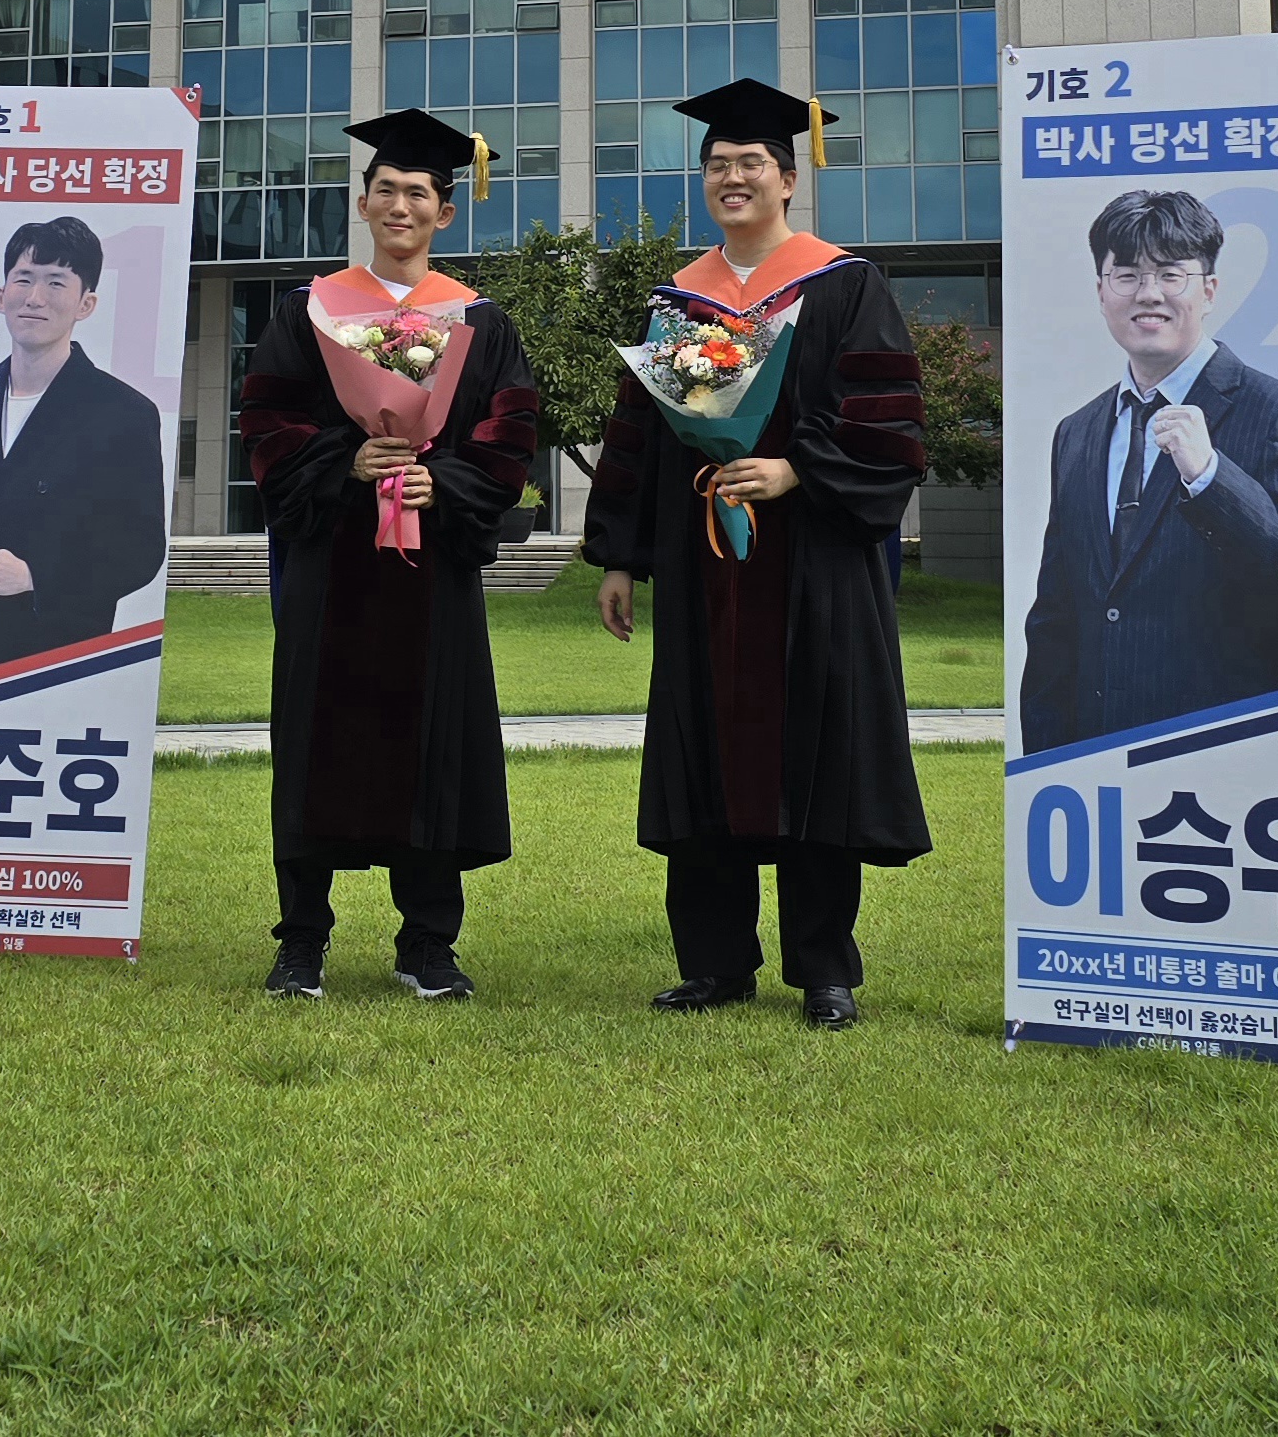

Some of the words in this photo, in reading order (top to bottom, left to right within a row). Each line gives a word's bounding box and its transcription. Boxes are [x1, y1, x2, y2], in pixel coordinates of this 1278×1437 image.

[1025, 67, 1090, 103] 기호
[1104, 60, 1132, 98] 2
[19, 100, 41, 133] 1
[1035, 125, 1115, 166] 박사
[1130, 121, 1209, 164] 당선
[27, 157, 92, 194] 당선
[101, 158, 169, 195] 확정
[22, 868, 83, 892] 100%
[50, 911, 82, 930] 선택
[1037, 948, 1126, 981] 20xx년
[1134, 954, 1207, 987] 대통령
[1215, 961, 1266, 992] 출마
[1054, 1000, 1130, 1025] 연구실의
[1136, 1006, 1194, 1031] 선택이
